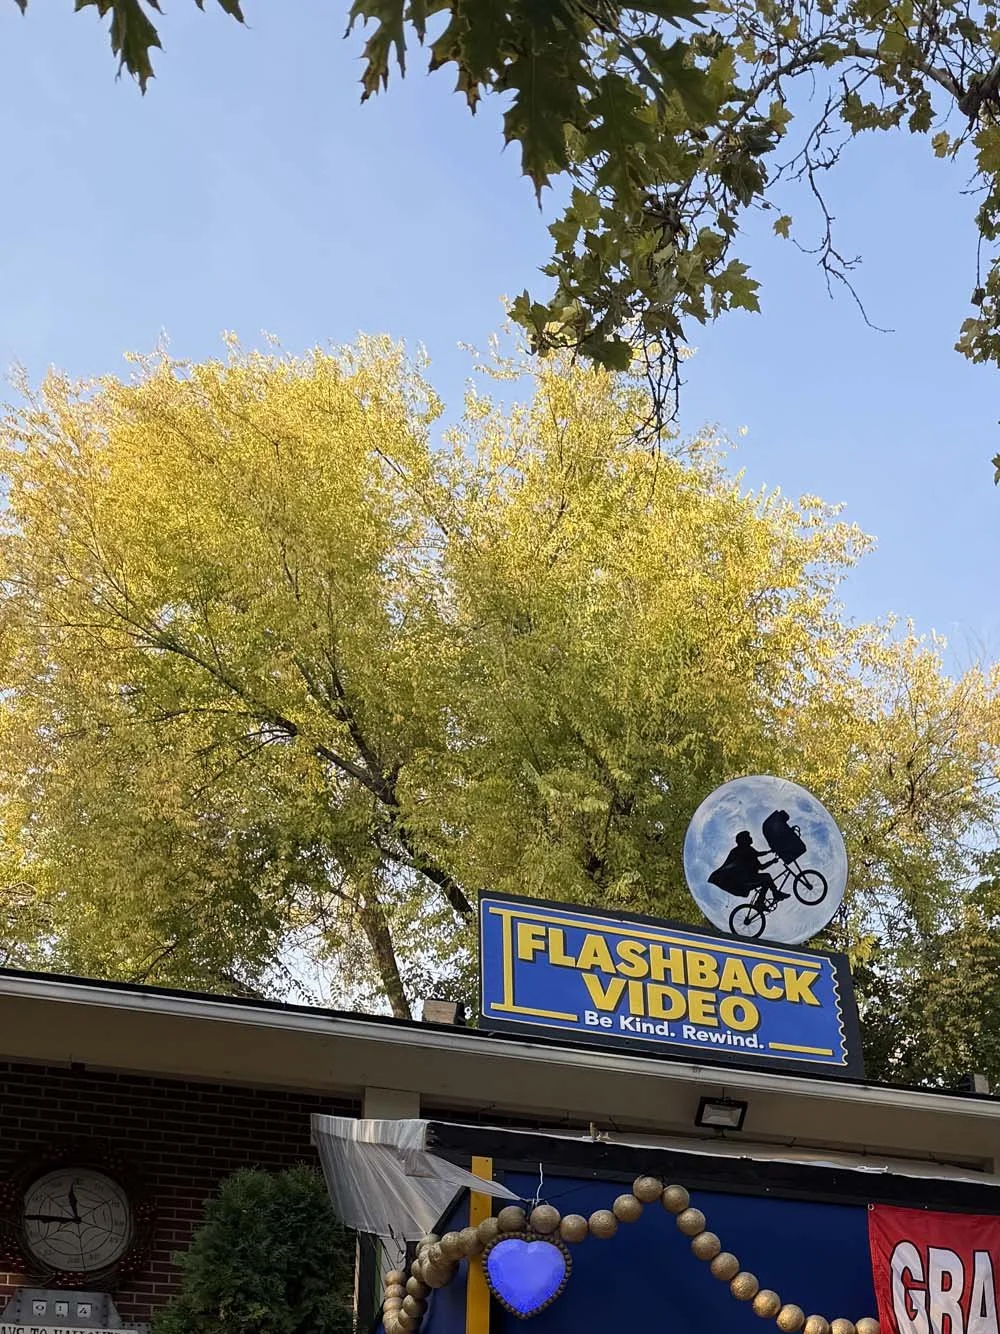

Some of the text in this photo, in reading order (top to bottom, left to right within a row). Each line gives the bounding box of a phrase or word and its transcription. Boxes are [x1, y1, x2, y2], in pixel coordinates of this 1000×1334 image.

[517, 923, 822, 1005] FLASHBACK
[582, 973, 759, 1031] VIDEO
[585, 1010, 764, 1049] Be Kind. Rewind.
